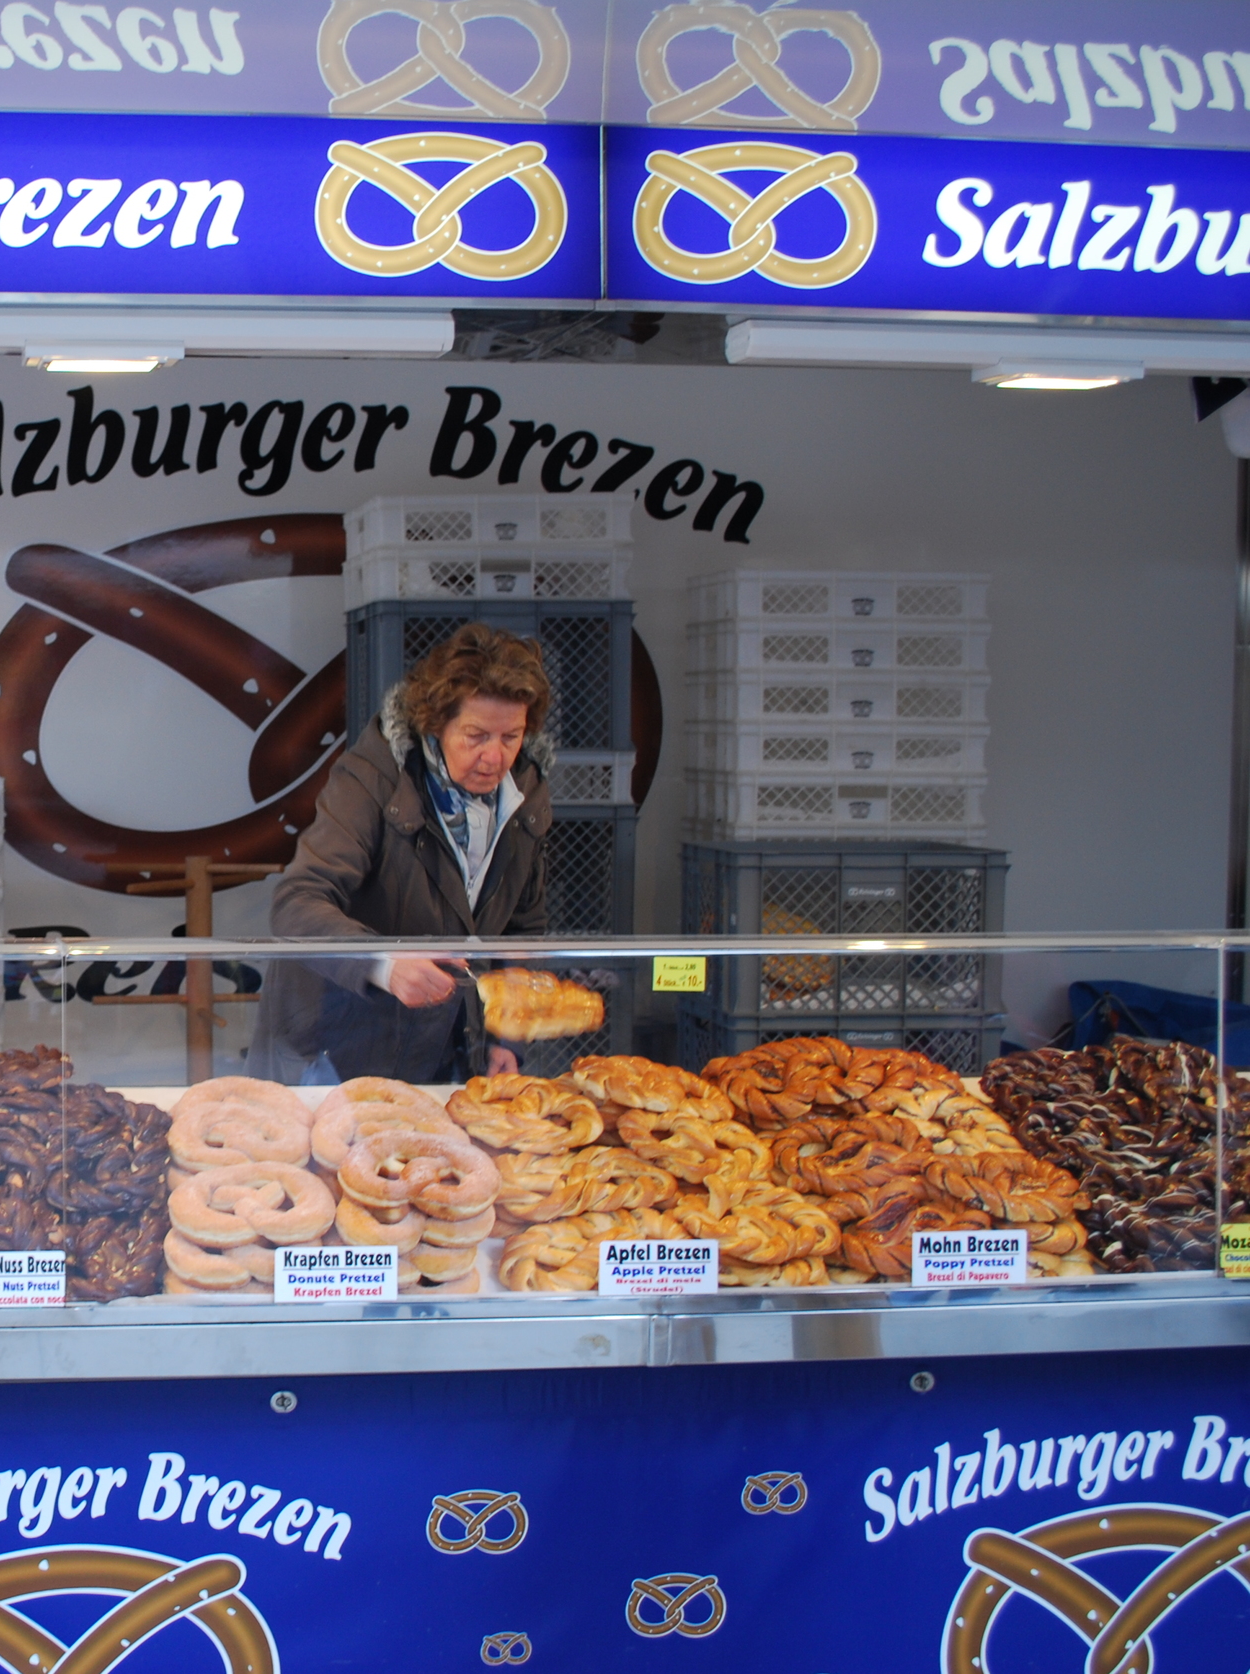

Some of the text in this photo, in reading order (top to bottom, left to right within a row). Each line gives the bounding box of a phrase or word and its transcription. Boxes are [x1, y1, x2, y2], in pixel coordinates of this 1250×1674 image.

[429, 385, 764, 544] Brezen
[919, 1236, 1019, 1254] Mohn Brezen
[284, 1250, 392, 1271] Krapfen Brezen
[606, 1244, 710, 1265] Apfel Brezen
[924, 1257, 1014, 1270] Poppy Pretzel
[612, 1265, 705, 1277] Apple Pretzel
[927, 1271, 1009, 1283] Brezel di Papavero
[288, 1273, 385, 1284] Donute Pretzel
[3, 1282, 24, 1291] Nuts
[27, 1280, 60, 1291] Pretzel
[294, 1286, 382, 1298] Krapfen Brezel
[31, 1296, 45, 1304] con
[863, 1415, 1250, 1543] Salzburger Br
[138, 1451, 352, 1561] Brezen
